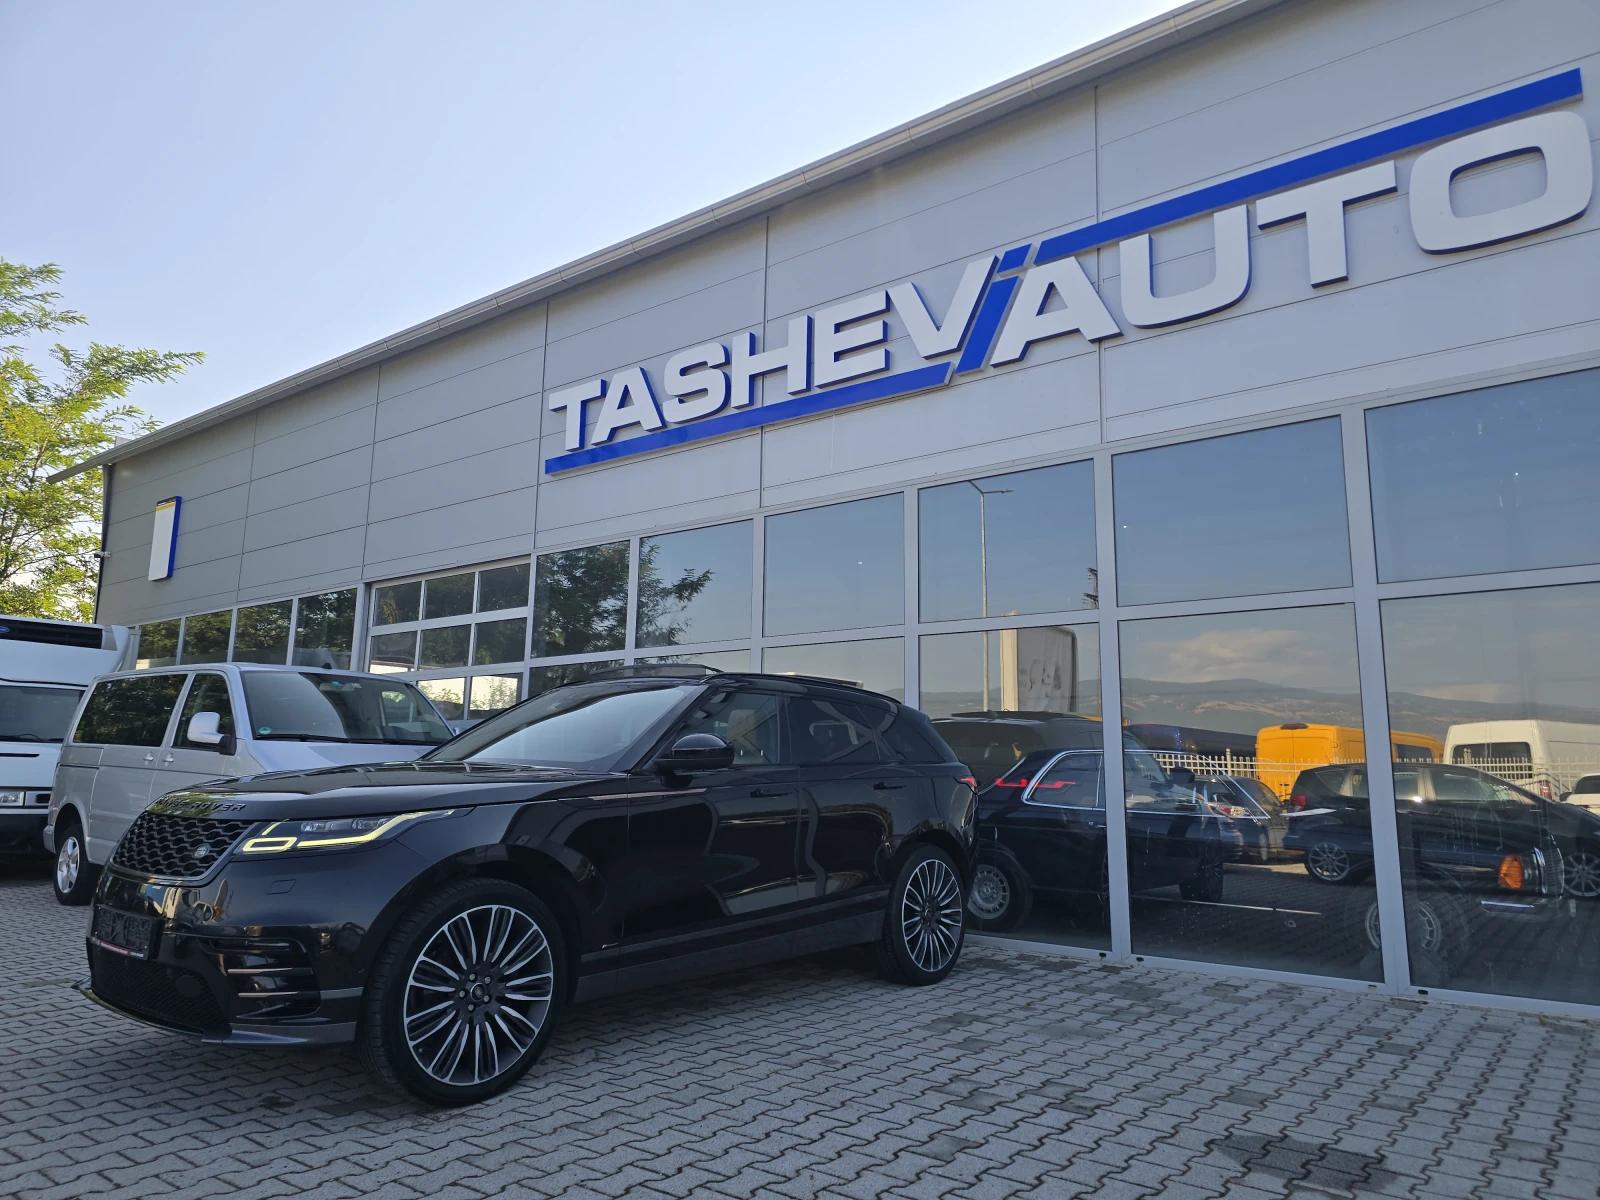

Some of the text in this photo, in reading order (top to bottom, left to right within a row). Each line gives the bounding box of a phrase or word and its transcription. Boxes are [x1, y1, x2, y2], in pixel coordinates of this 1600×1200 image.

[548, 110, 1595, 453] TASHEV AUTO
[190, 801, 247, 812] ROVER
